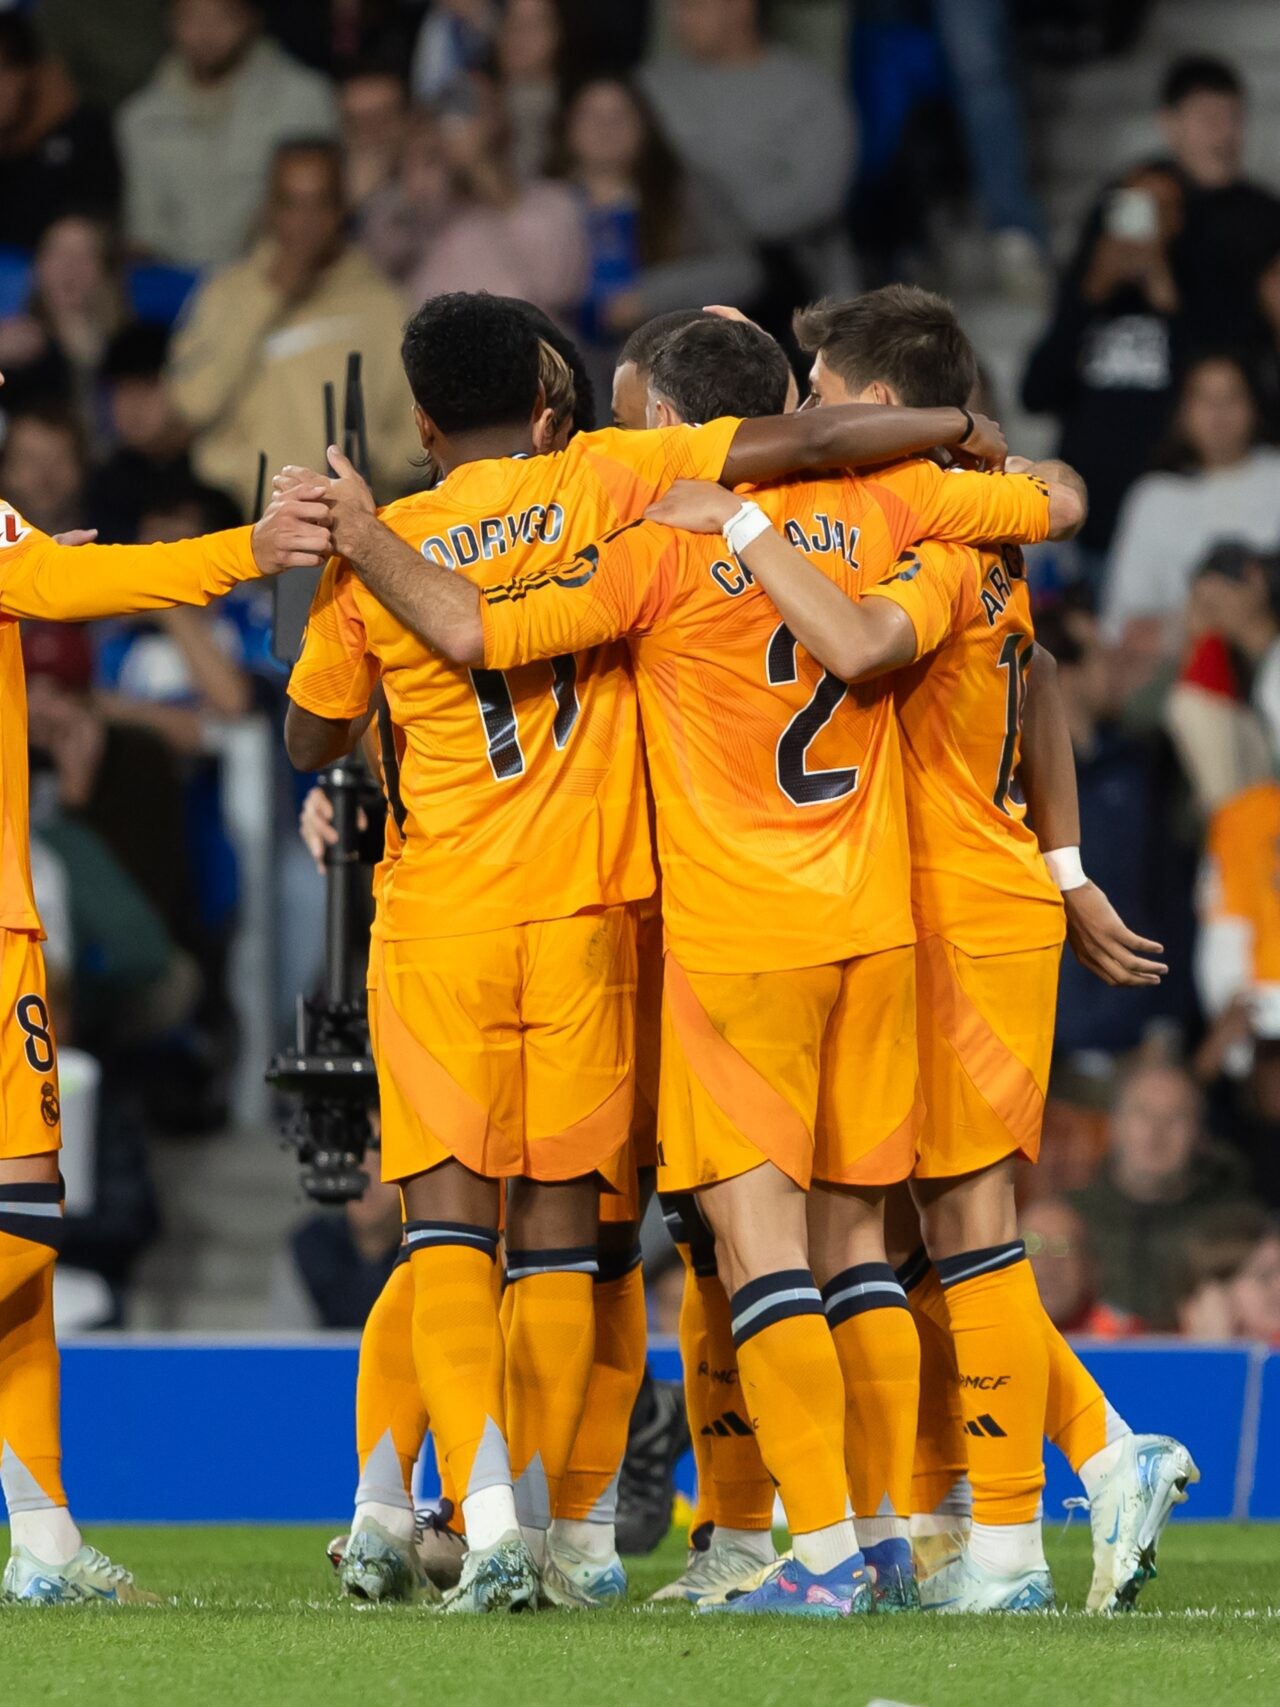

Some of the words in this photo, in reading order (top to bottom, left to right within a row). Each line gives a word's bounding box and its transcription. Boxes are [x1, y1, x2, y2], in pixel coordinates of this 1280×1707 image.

[420, 502, 565, 572] ODRYGO
[766, 619, 860, 806] 2
[15, 993, 55, 1073] 8
